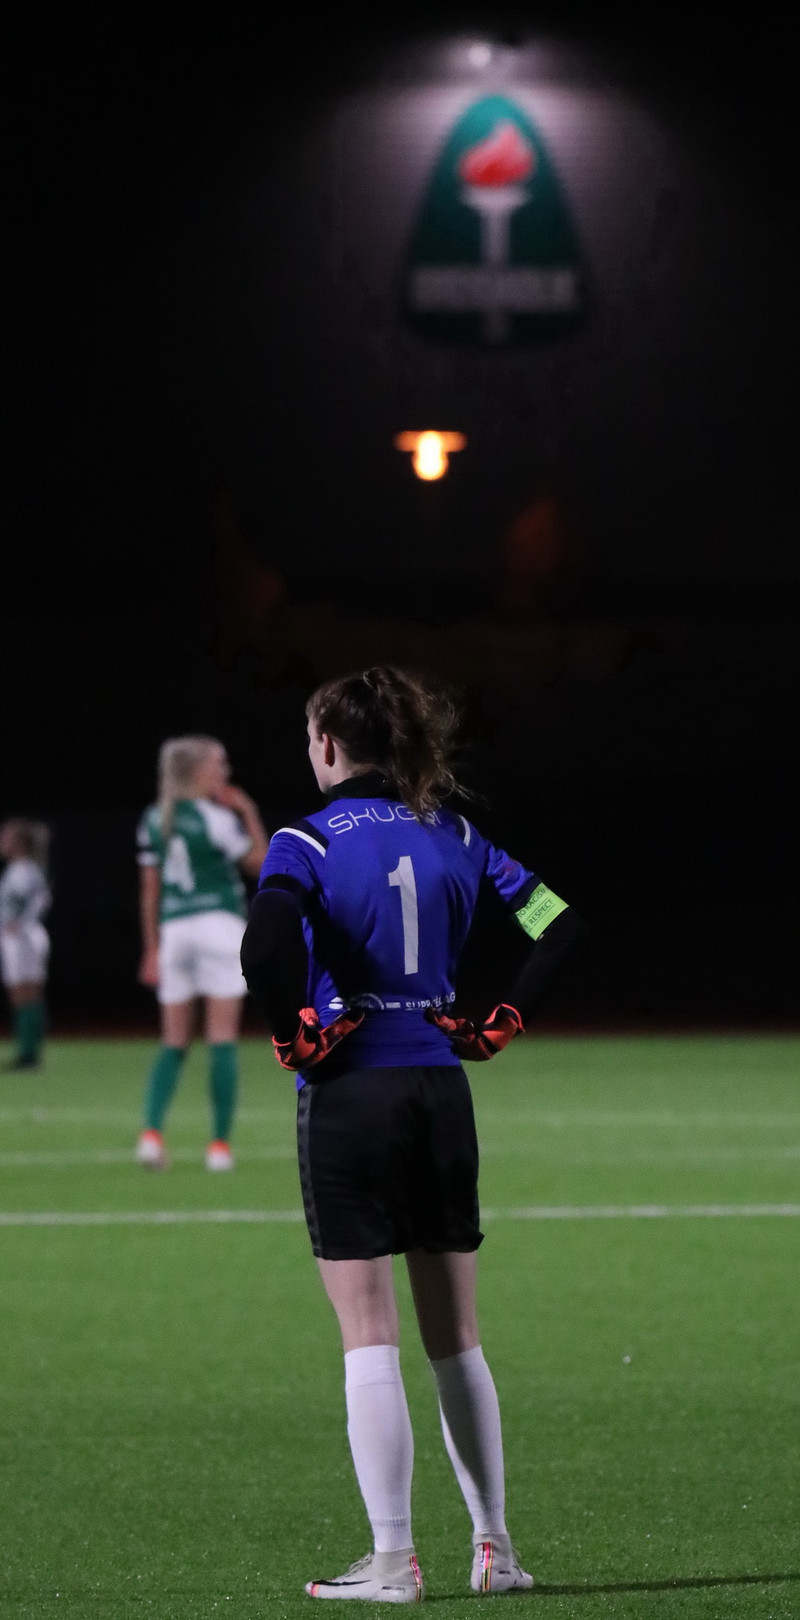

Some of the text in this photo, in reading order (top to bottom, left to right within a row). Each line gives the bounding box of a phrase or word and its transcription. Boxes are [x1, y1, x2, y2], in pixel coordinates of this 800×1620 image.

[163, 836, 195, 892] 4
[388, 855, 419, 975] 1
[528, 899, 553, 925] RESPECT
